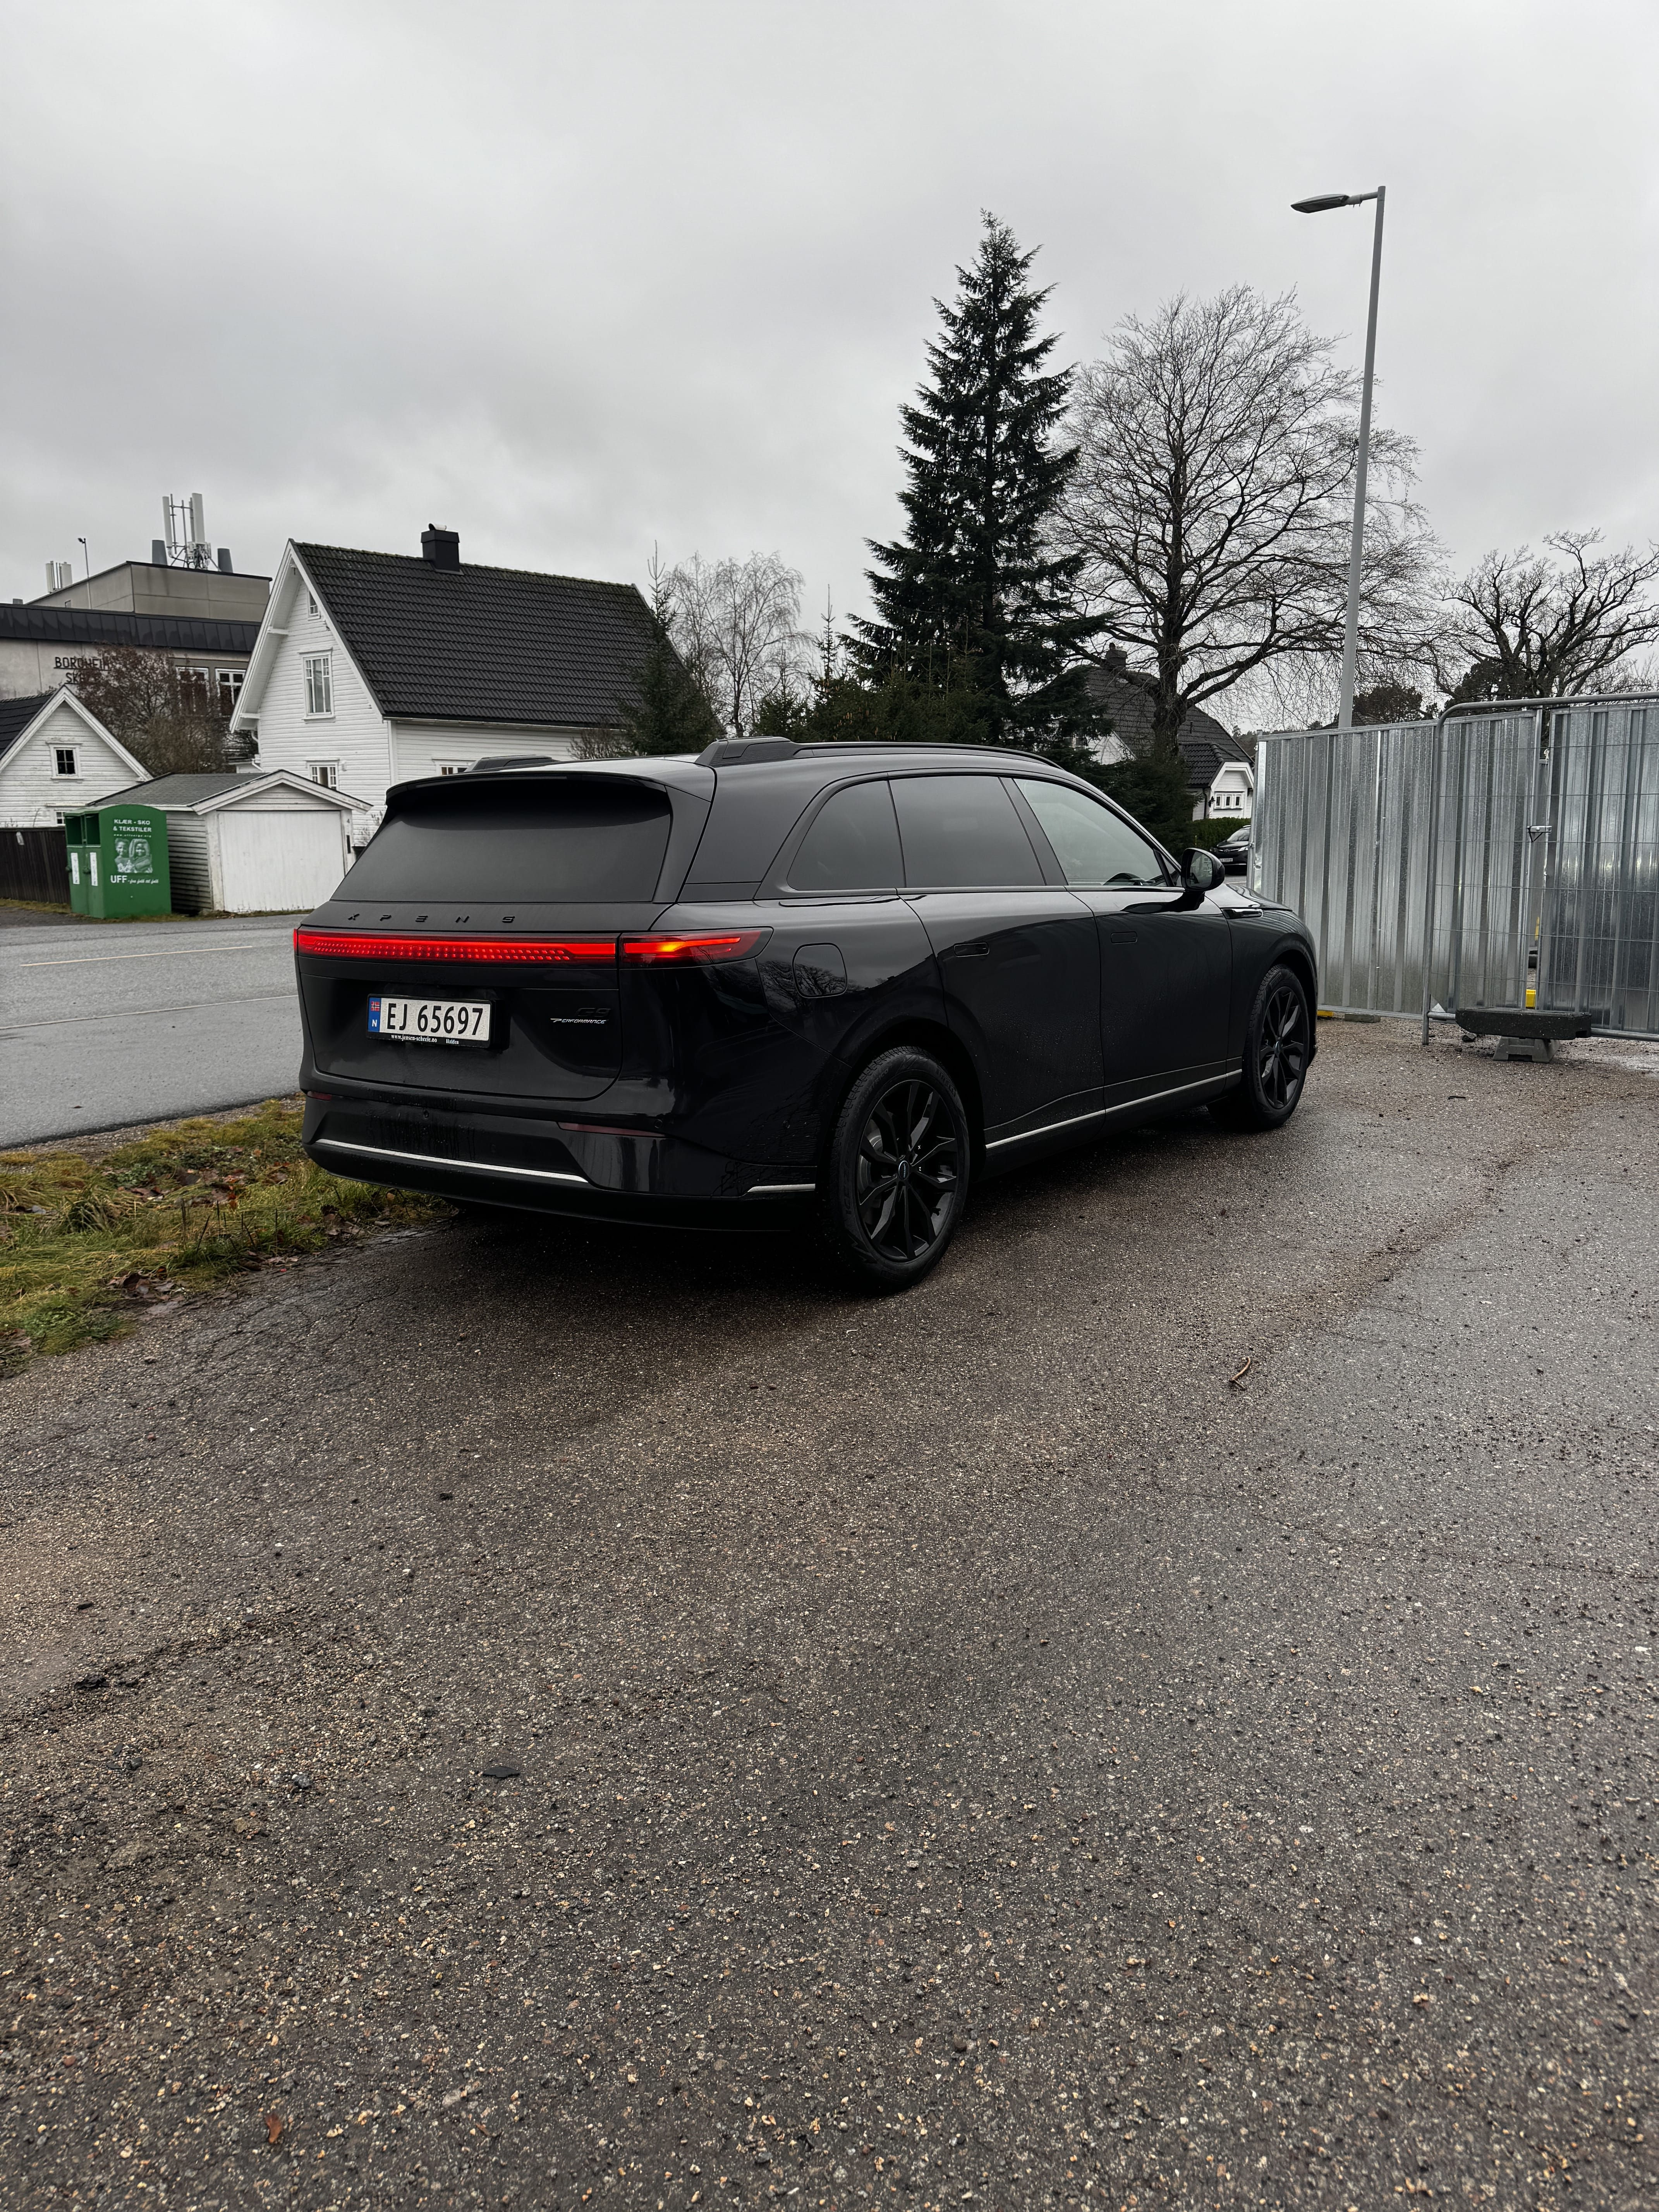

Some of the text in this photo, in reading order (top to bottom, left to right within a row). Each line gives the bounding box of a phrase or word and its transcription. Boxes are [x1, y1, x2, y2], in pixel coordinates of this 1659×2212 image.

[110, 875, 127, 883] UFF
[575, 1008, 611, 1017] G9
[387, 1003, 407, 1030] EJ
[417, 1005, 483, 1036] 65697
